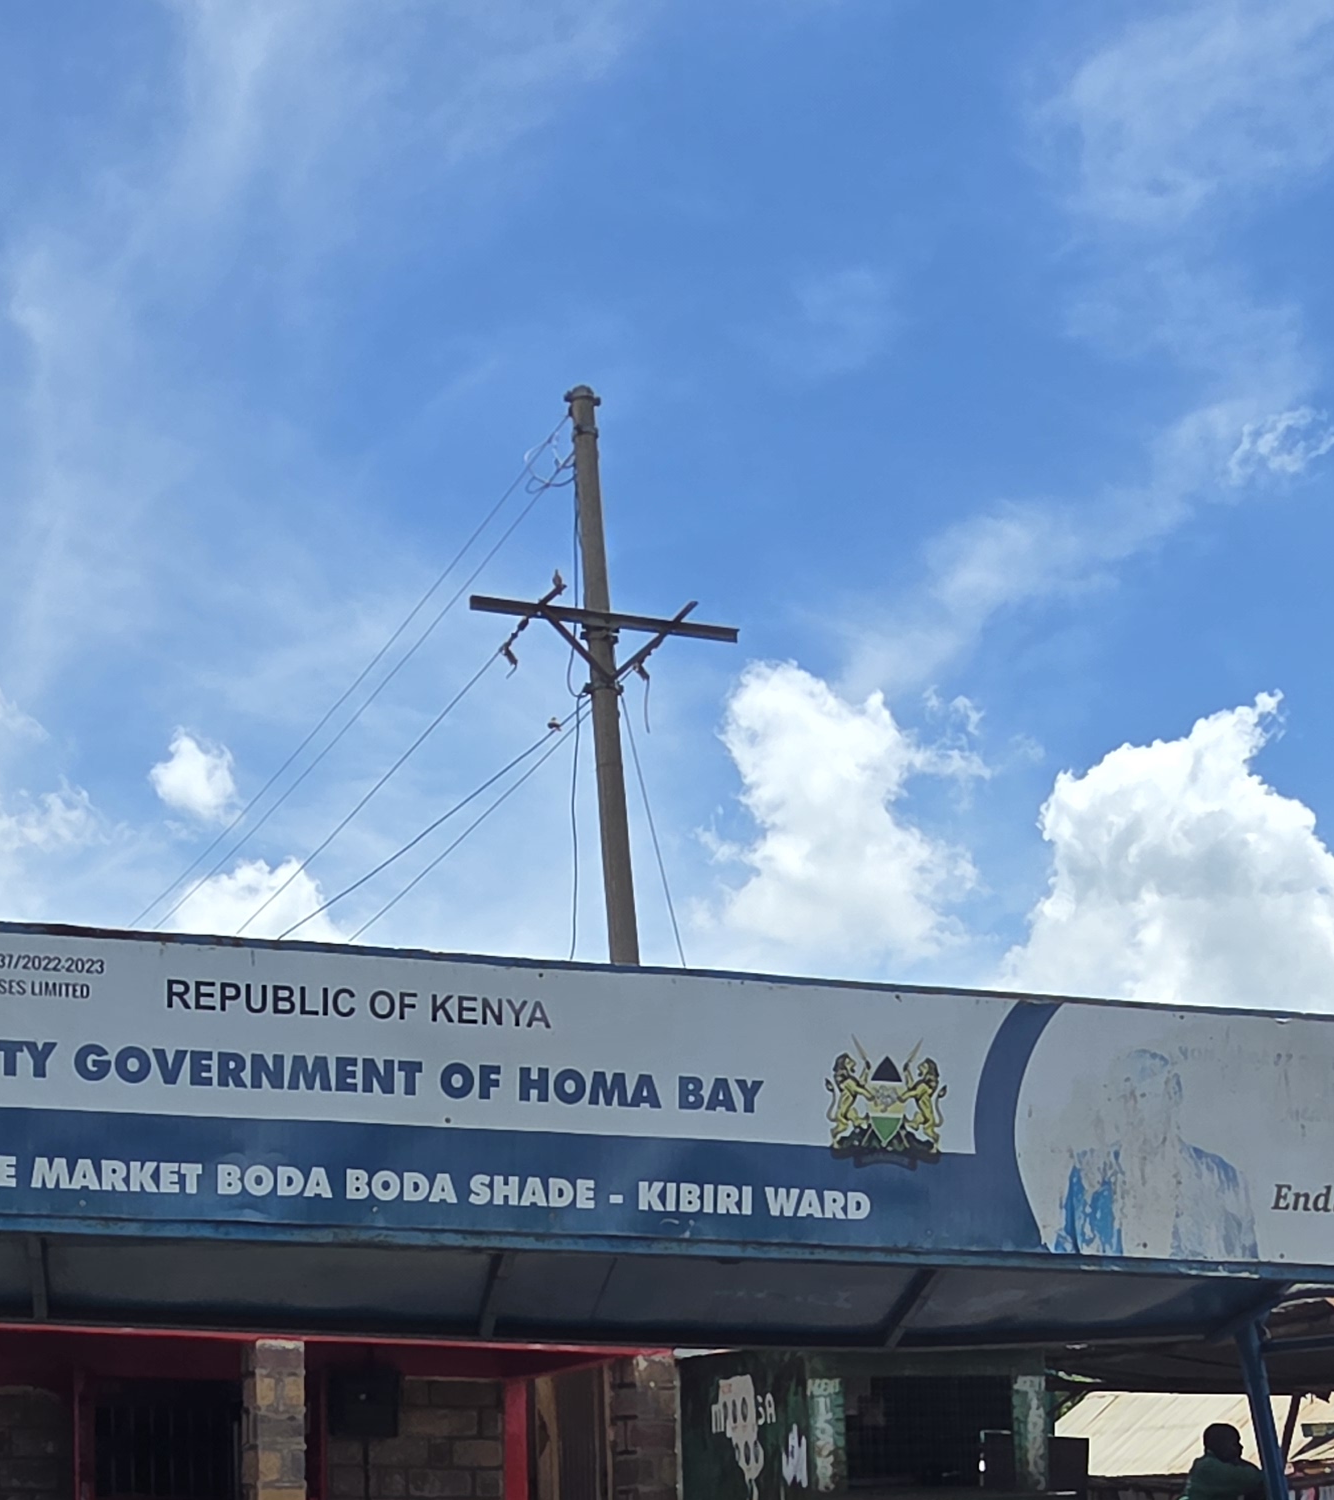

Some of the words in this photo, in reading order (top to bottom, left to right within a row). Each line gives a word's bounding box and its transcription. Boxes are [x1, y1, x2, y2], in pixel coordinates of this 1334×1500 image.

[30, 978, 91, 999] LIMITED
[166, 978, 356, 1018] REPUBLIC
[369, 990, 418, 1020] OF
[430, 993, 551, 1029] KENYA
[74, 1043, 423, 1096] GOVERNMENT
[440, 1062, 502, 1100] OF
[518, 1067, 662, 1109] HOMA
[677, 1076, 764, 1114] BAY
[30, 1157, 203, 1195] MARKET
[217, 1165, 334, 1199] BODA
[345, 1168, 458, 1204] BODA
[468, 1173, 596, 1209] SHADE
[638, 1181, 754, 1216] KIBIRI
[765, 1186, 871, 1220] WARD
